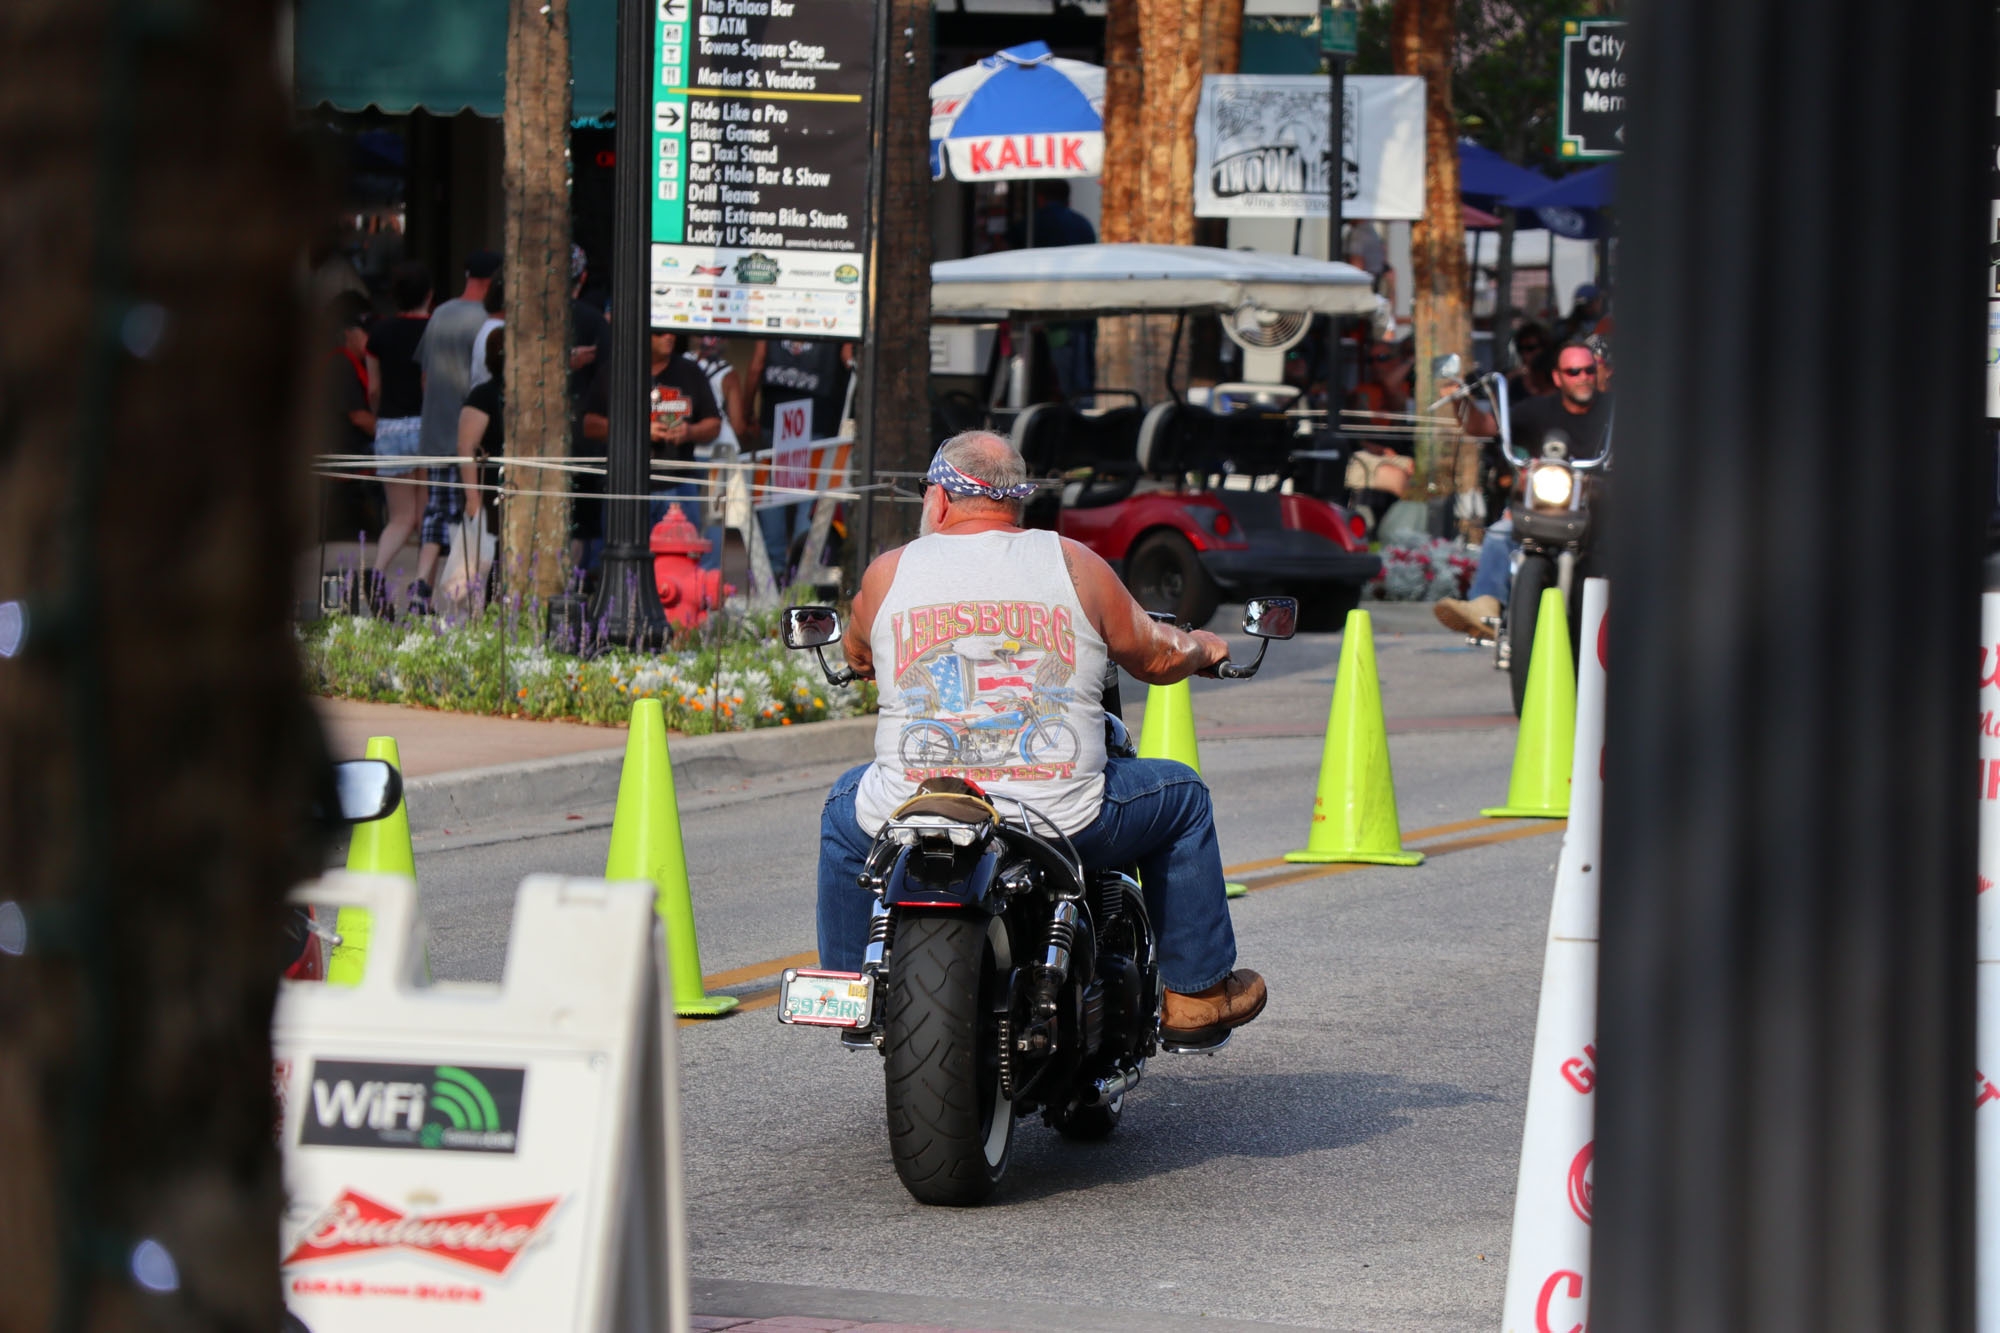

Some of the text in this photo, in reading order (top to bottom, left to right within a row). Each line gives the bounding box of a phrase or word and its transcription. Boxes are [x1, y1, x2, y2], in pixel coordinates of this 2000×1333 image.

[701, 0, 795, 17] The Palace Bar
[719, 18, 747, 35] ATM
[699, 37, 825, 61] Towne Square Stage
[1587, 35, 1625, 61] City
[698, 67, 816, 90] Market St. Vendors
[691, 101, 788, 124] Ride Like a Pro
[690, 122, 770, 143] Biker Games
[712, 143, 778, 164] Taxi Stand
[970, 135, 1087, 173] KALIK
[690, 163, 831, 187] Rat's Hole Bar & Show
[688, 183, 760, 205] Drill Teams
[687, 204, 849, 230] Team Extreme Bike Stunts
[687, 225, 783, 247] Lucky U Saloon
[781, 407, 805, 440] NO
[891, 600, 1076, 687] LEESBURG
[313, 1079, 426, 1131] WiFi
